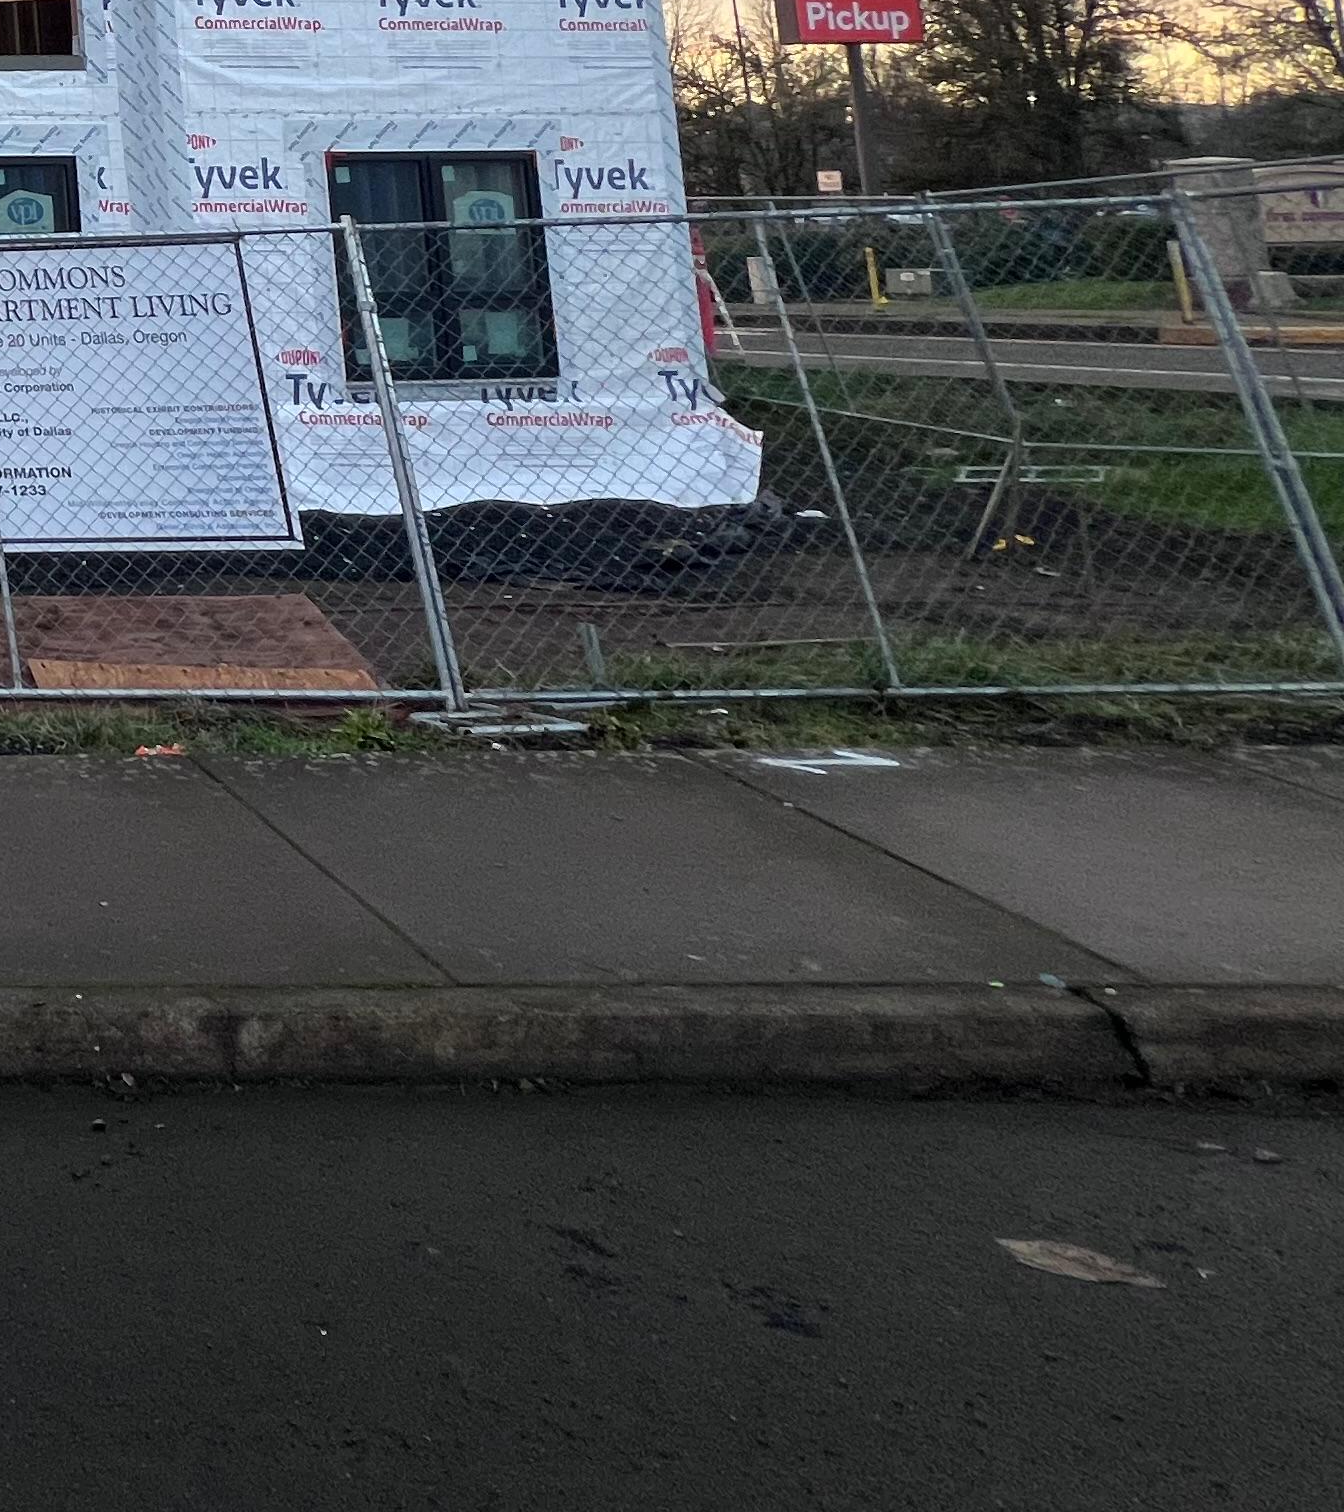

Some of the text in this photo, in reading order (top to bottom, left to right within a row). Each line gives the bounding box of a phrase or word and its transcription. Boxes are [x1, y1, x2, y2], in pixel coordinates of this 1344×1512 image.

[806, 2, 909, 39] Pickup
[133, 293, 233, 317] LIVING
[7, 335, 25, 347] 20
[29, 332, 66, 347] Units
[81, 331, 130, 346] Dallas,
[134, 329, 187, 346] Oregon
[4, 382, 74, 395] Corporation
[17, 427, 30, 437] of
[33, 425, 72, 436] Dallas
